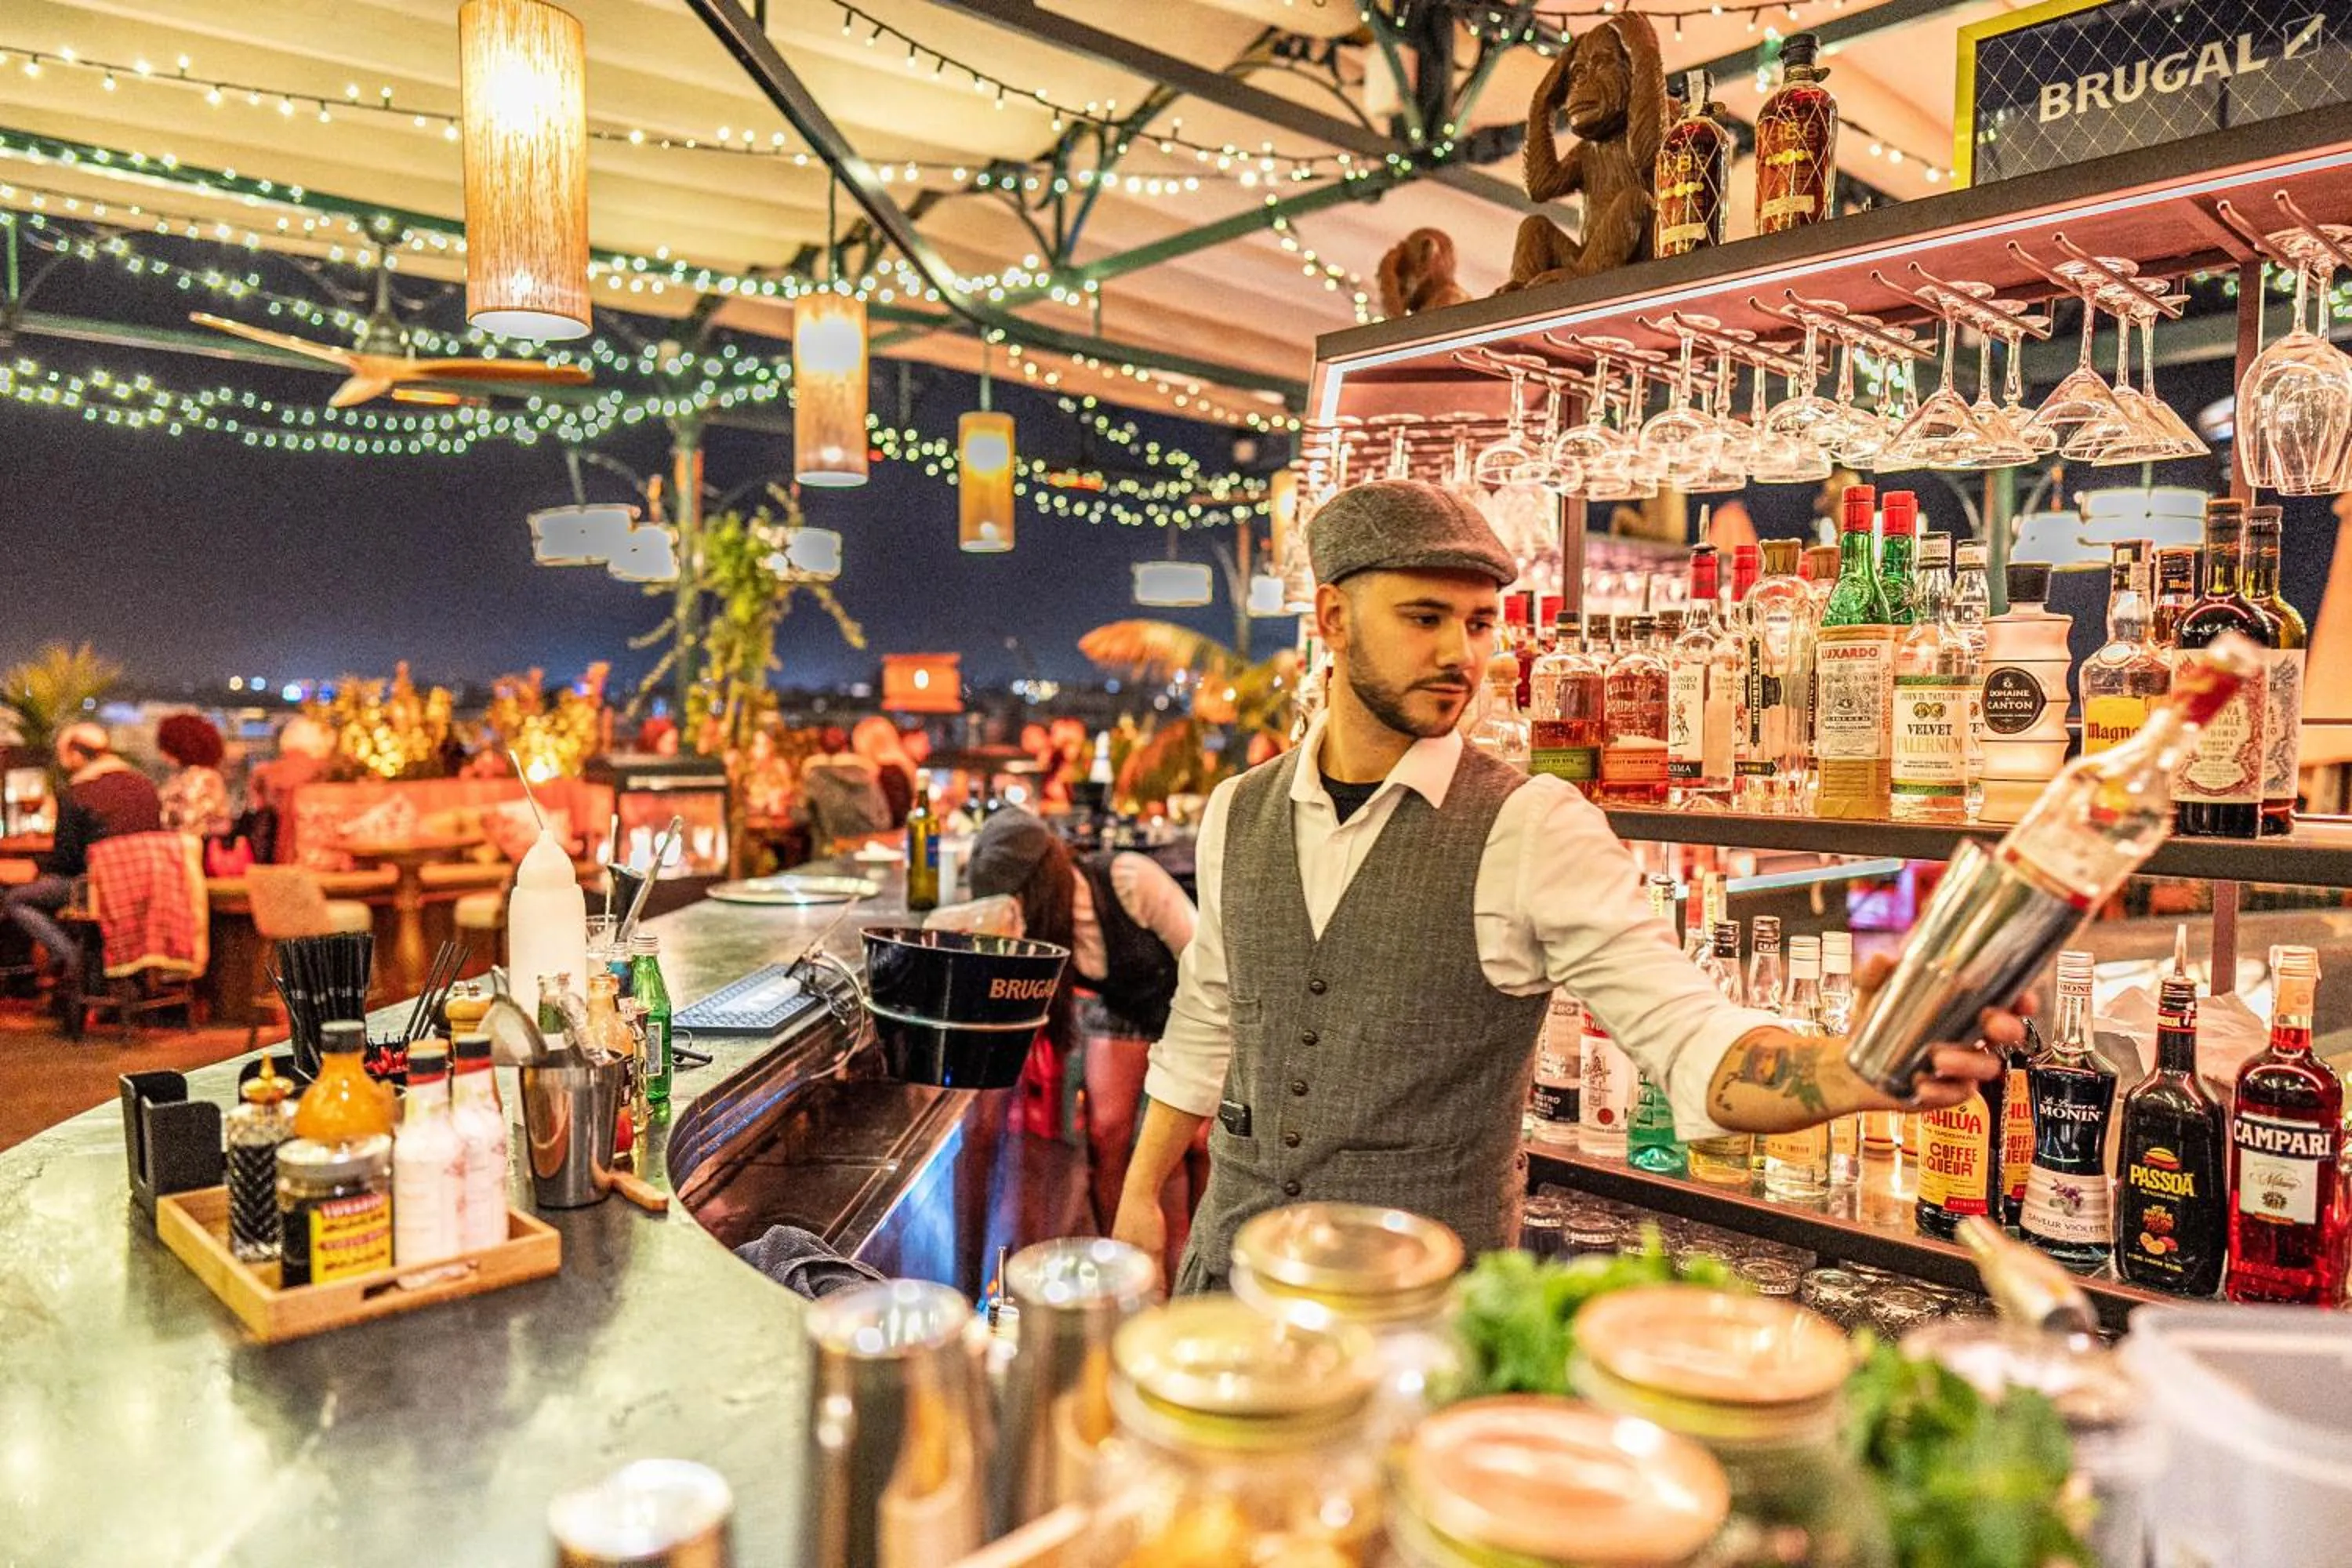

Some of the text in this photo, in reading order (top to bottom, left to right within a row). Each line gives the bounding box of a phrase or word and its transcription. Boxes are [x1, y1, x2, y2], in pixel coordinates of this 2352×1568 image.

[2039, 32, 2270, 124] BRUGAL
[1820, 647, 1878, 659] LUXARDO
[1987, 701, 2033, 710] CANTON
[1907, 724, 1953, 735] VELVET
[989, 978, 1056, 1000] BRUGA
[2040, 1103, 2100, 1122] MONIN
[2234, 1119, 2332, 1156] CAMPARI
[1929, 1142, 1978, 1163] COFFEE
[2027, 1212, 2062, 1229] SAVEUR
